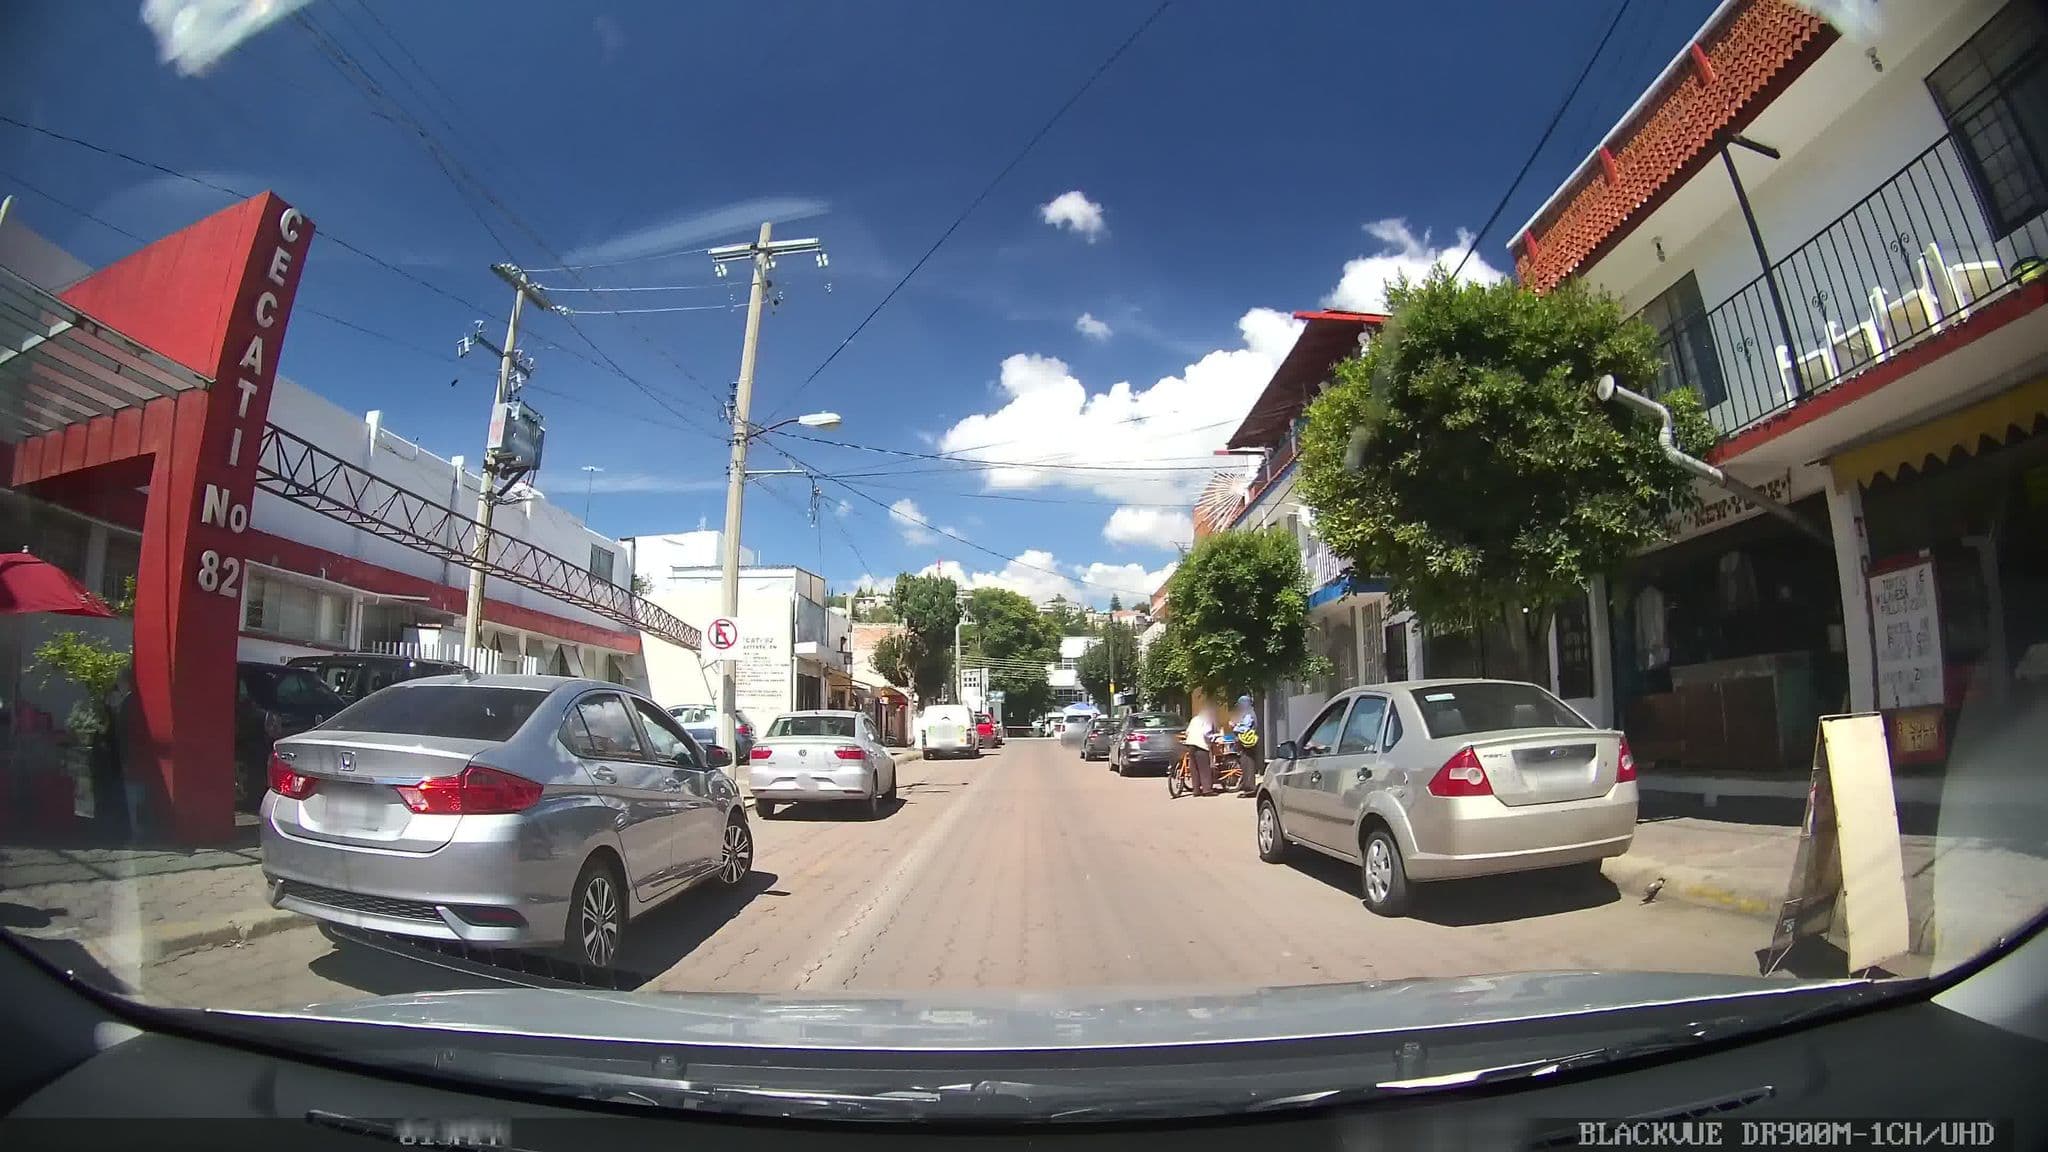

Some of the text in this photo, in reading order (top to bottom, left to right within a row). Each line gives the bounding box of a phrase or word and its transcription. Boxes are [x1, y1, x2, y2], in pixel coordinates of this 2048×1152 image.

[229, 208, 302, 467] CECATI
[202, 484, 247, 533] No
[198, 550, 240, 598] 82
